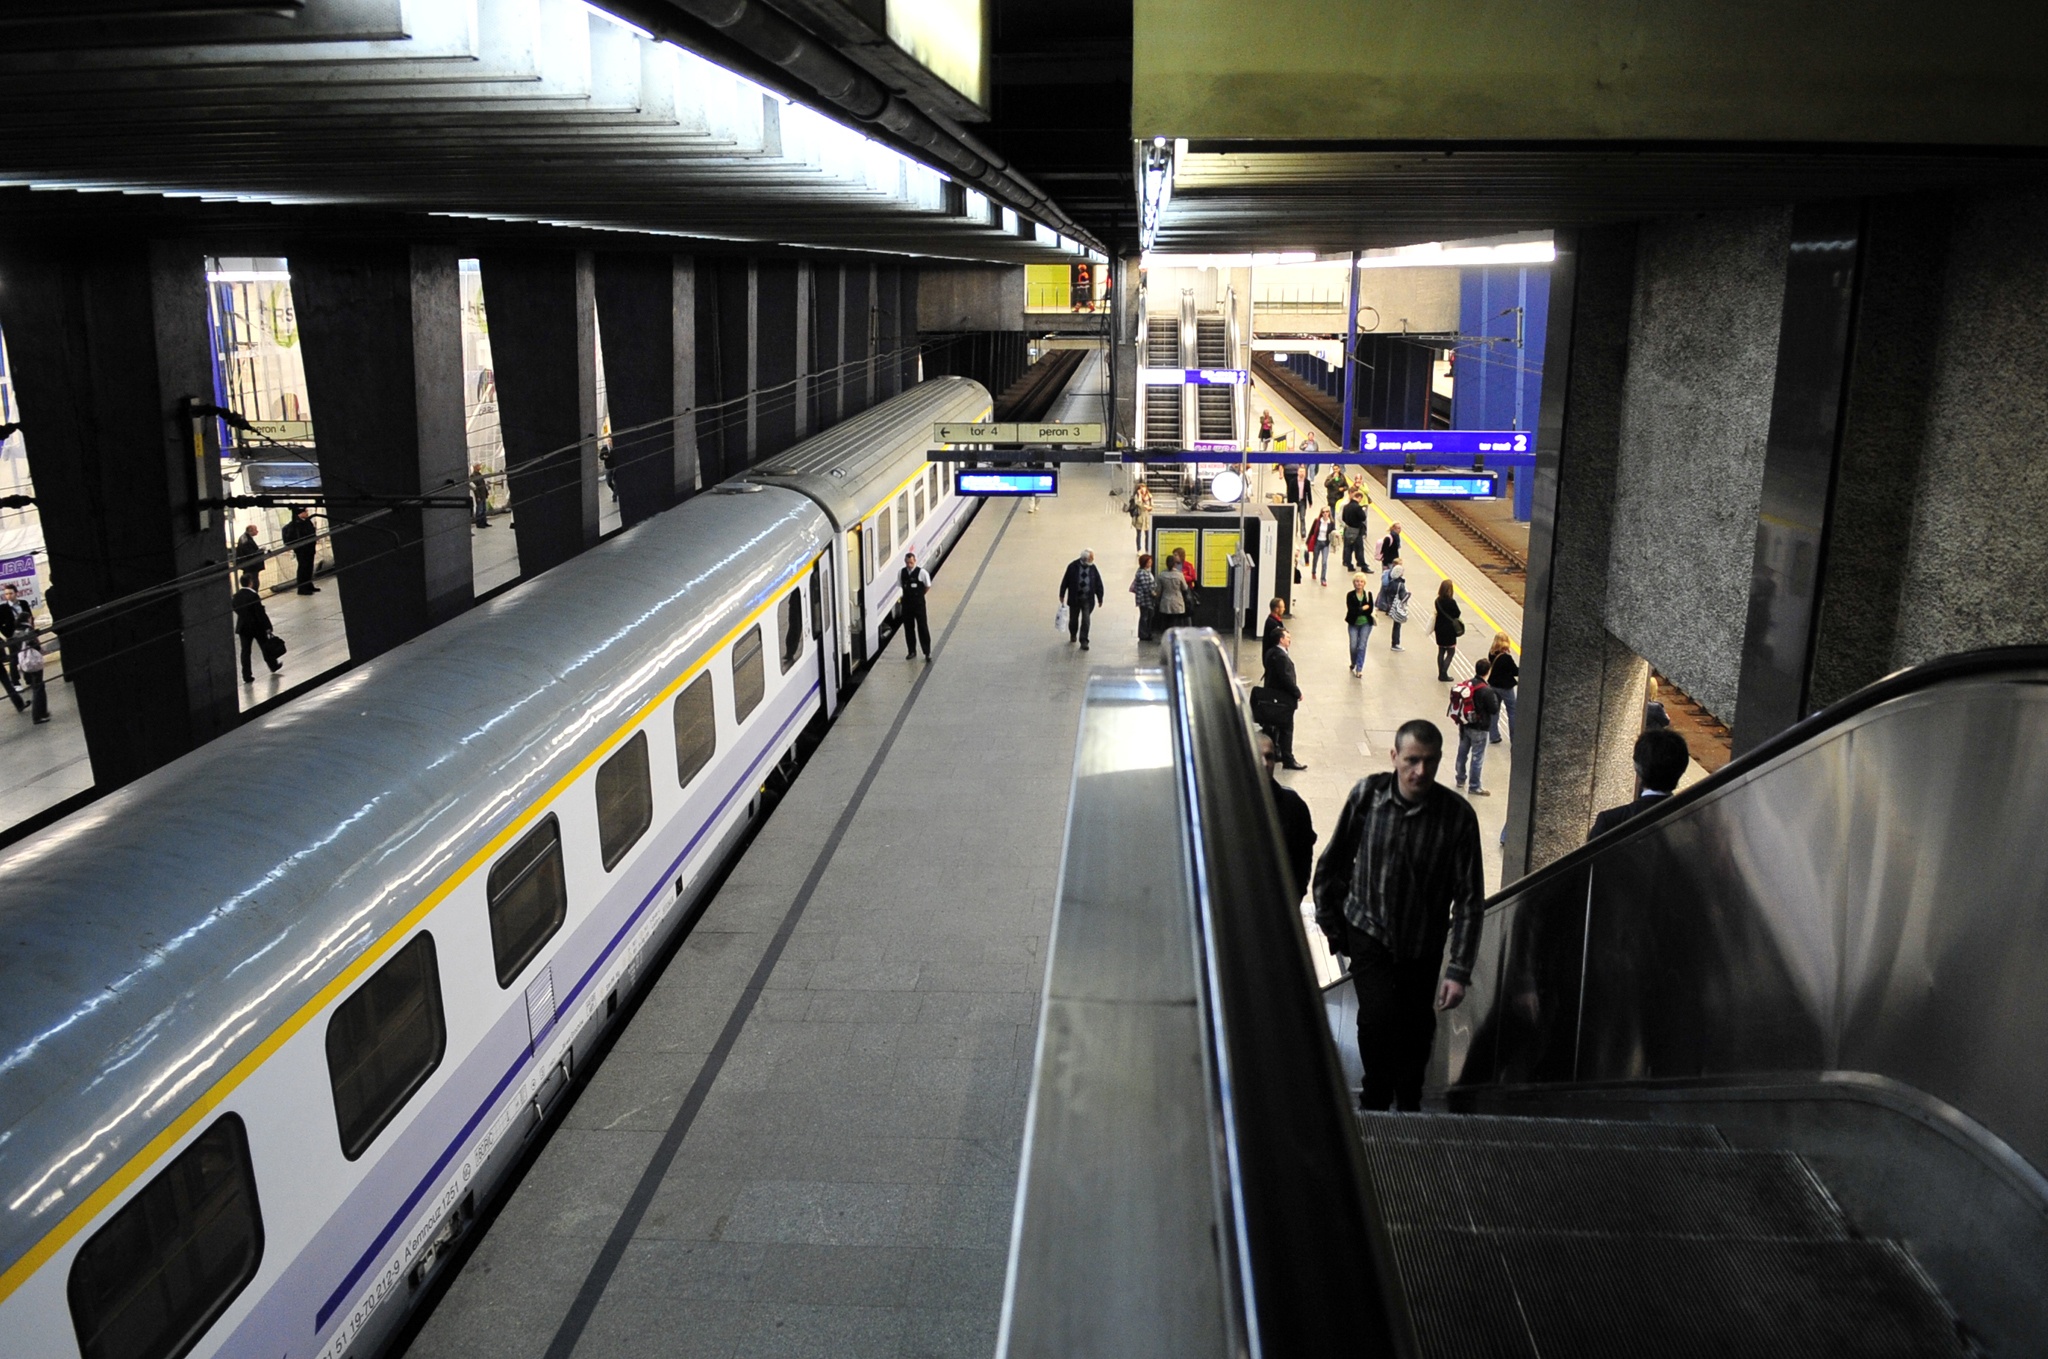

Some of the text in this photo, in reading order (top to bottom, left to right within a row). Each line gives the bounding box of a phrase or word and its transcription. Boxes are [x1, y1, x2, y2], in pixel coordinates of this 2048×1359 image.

[279, 425, 286, 433] 4
[970, 426, 998, 436] tor 4
[1039, 427, 1081, 437] peron 3
[1364, 433, 1377, 450] 3
[1513, 434, 1527, 451] 2
[0, 558, 34, 577] IBRA
[336, 1331, 347, 1354] 51
[350, 1294, 375, 1333] 19-70
[376, 1259, 400, 1299] 212-9
[442, 1180, 460, 1210] 1251
